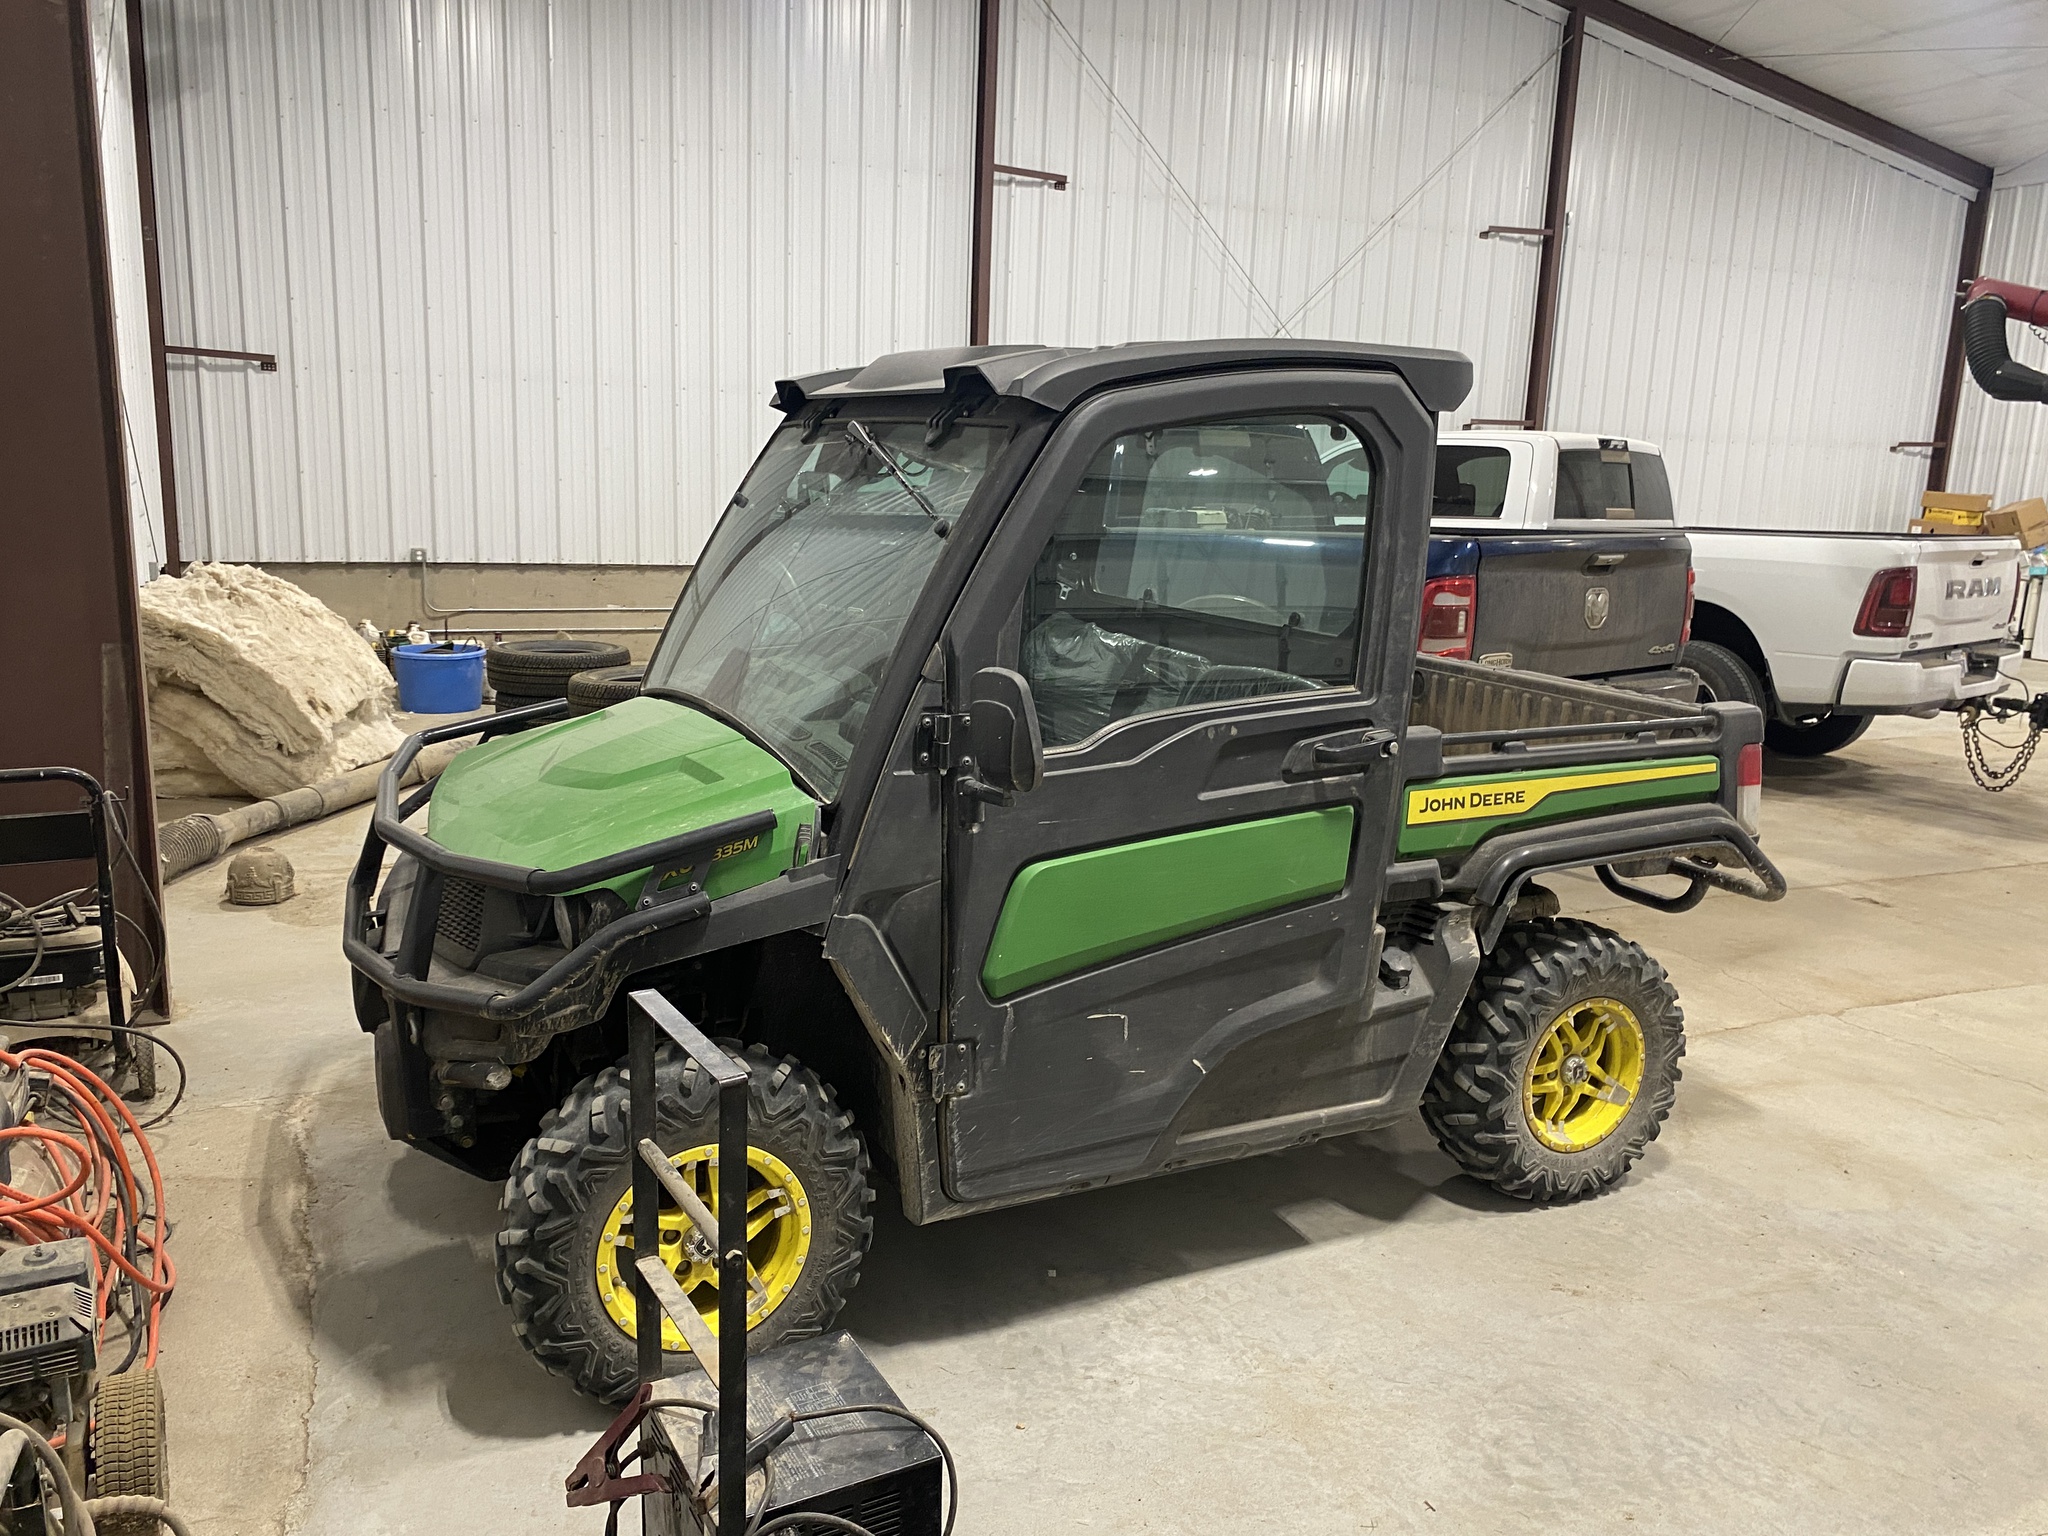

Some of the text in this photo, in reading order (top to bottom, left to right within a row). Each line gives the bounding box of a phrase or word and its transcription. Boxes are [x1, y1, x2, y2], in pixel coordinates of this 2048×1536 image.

[1946, 577, 2001, 600] RAM
[1419, 790, 1526, 813] JOHN DEERE
